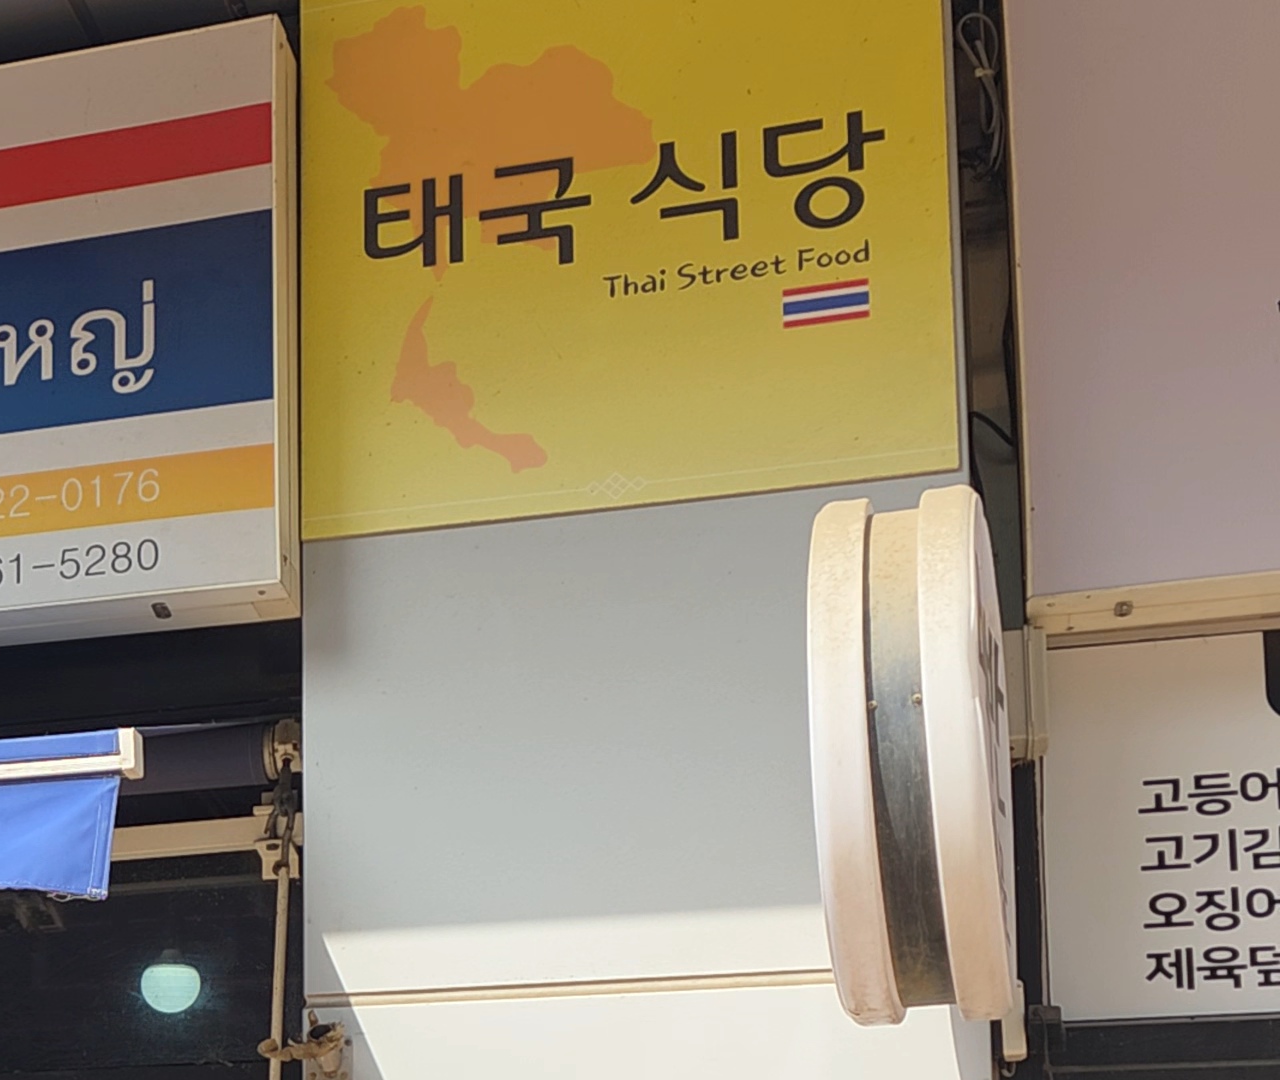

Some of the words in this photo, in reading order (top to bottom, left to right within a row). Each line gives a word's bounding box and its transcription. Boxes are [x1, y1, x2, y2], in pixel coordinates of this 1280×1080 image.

[363, 156, 592, 267] 태국
[630, 110, 886, 240] 식당
[602, 270, 667, 299] Thai
[677, 253, 786, 291] Street
[796, 240, 871, 271] Food
